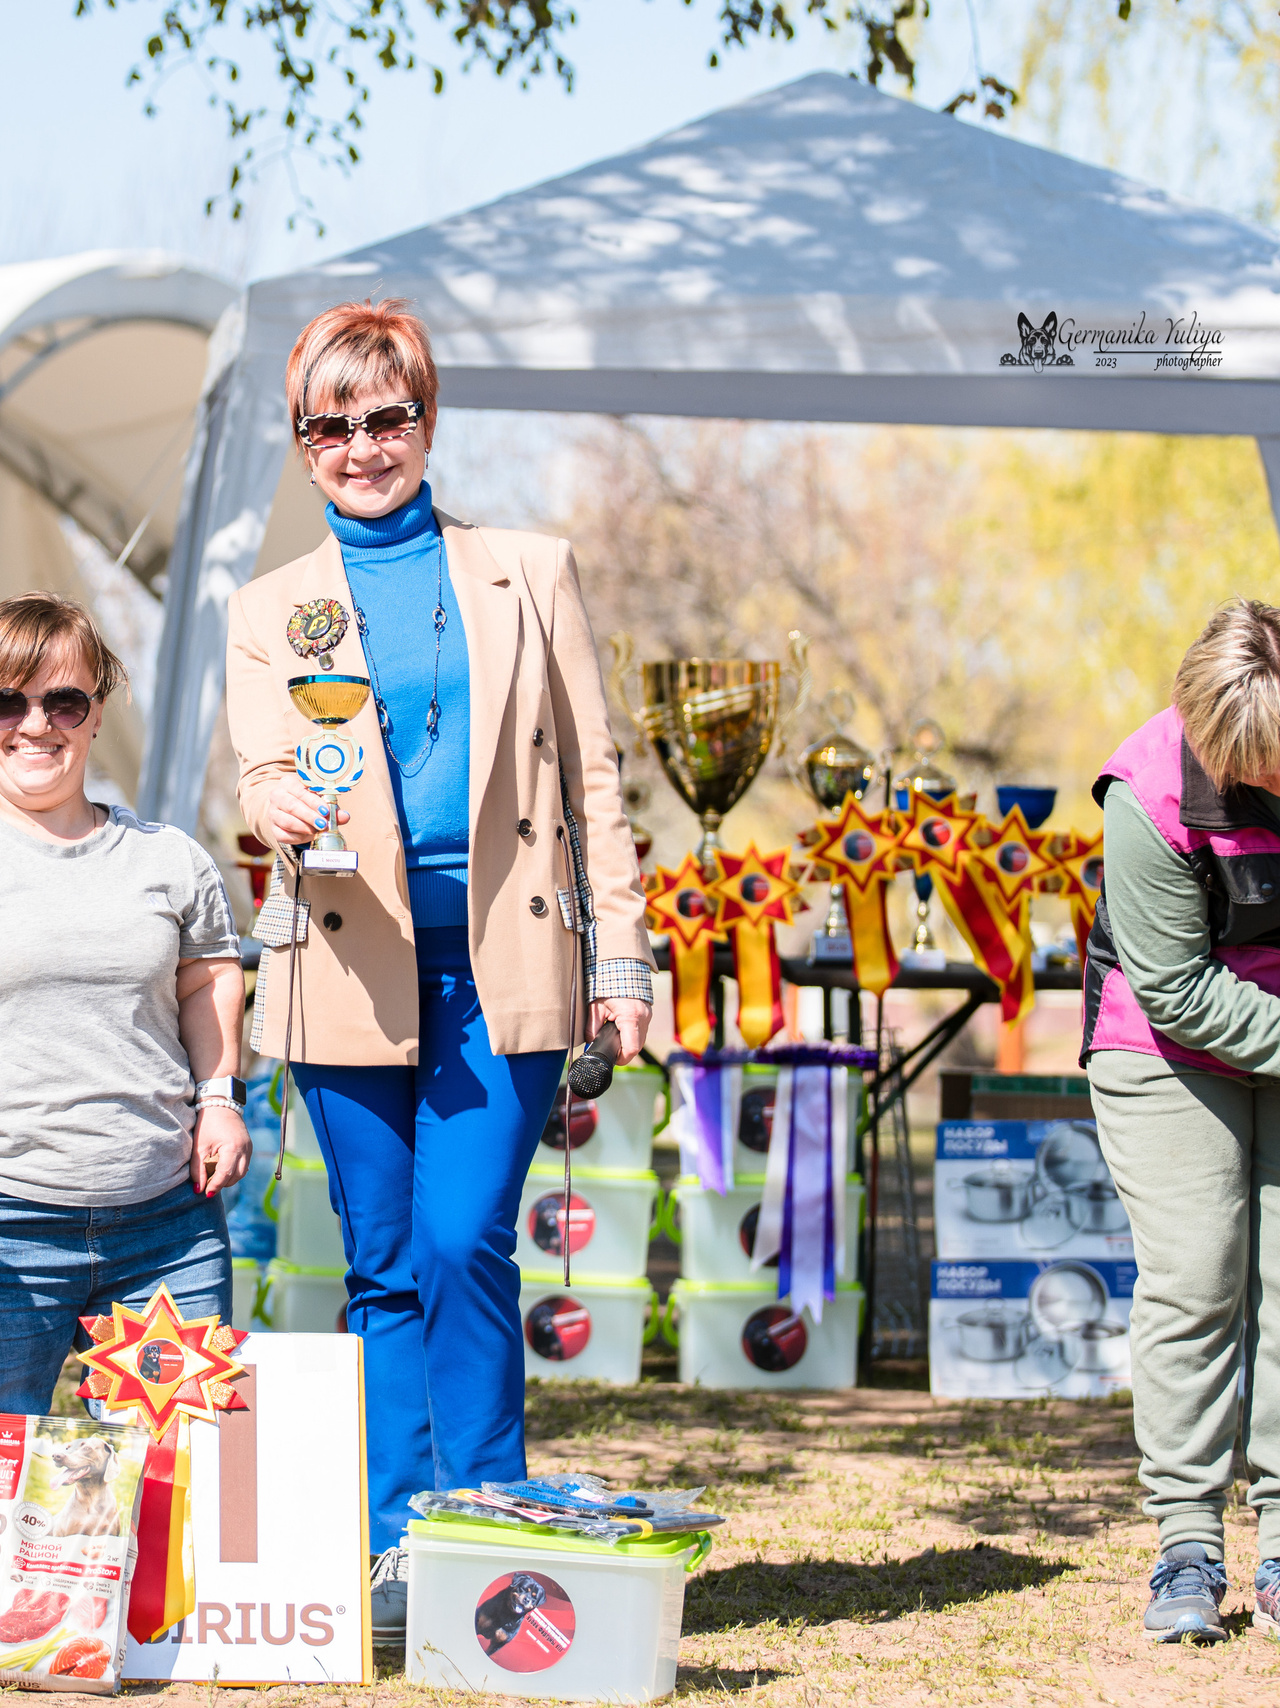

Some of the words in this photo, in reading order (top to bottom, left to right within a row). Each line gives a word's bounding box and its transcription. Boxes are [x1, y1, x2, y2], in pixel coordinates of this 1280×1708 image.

[943, 1127, 995, 1139] НАБОР
[21, 1514, 46, 1528] 40%
[20, 1539, 62, 1552] МЯСНОЙ
[19, 1547, 59, 1559] РАЦИОН
[144, 1602, 334, 1646] IRIUS
